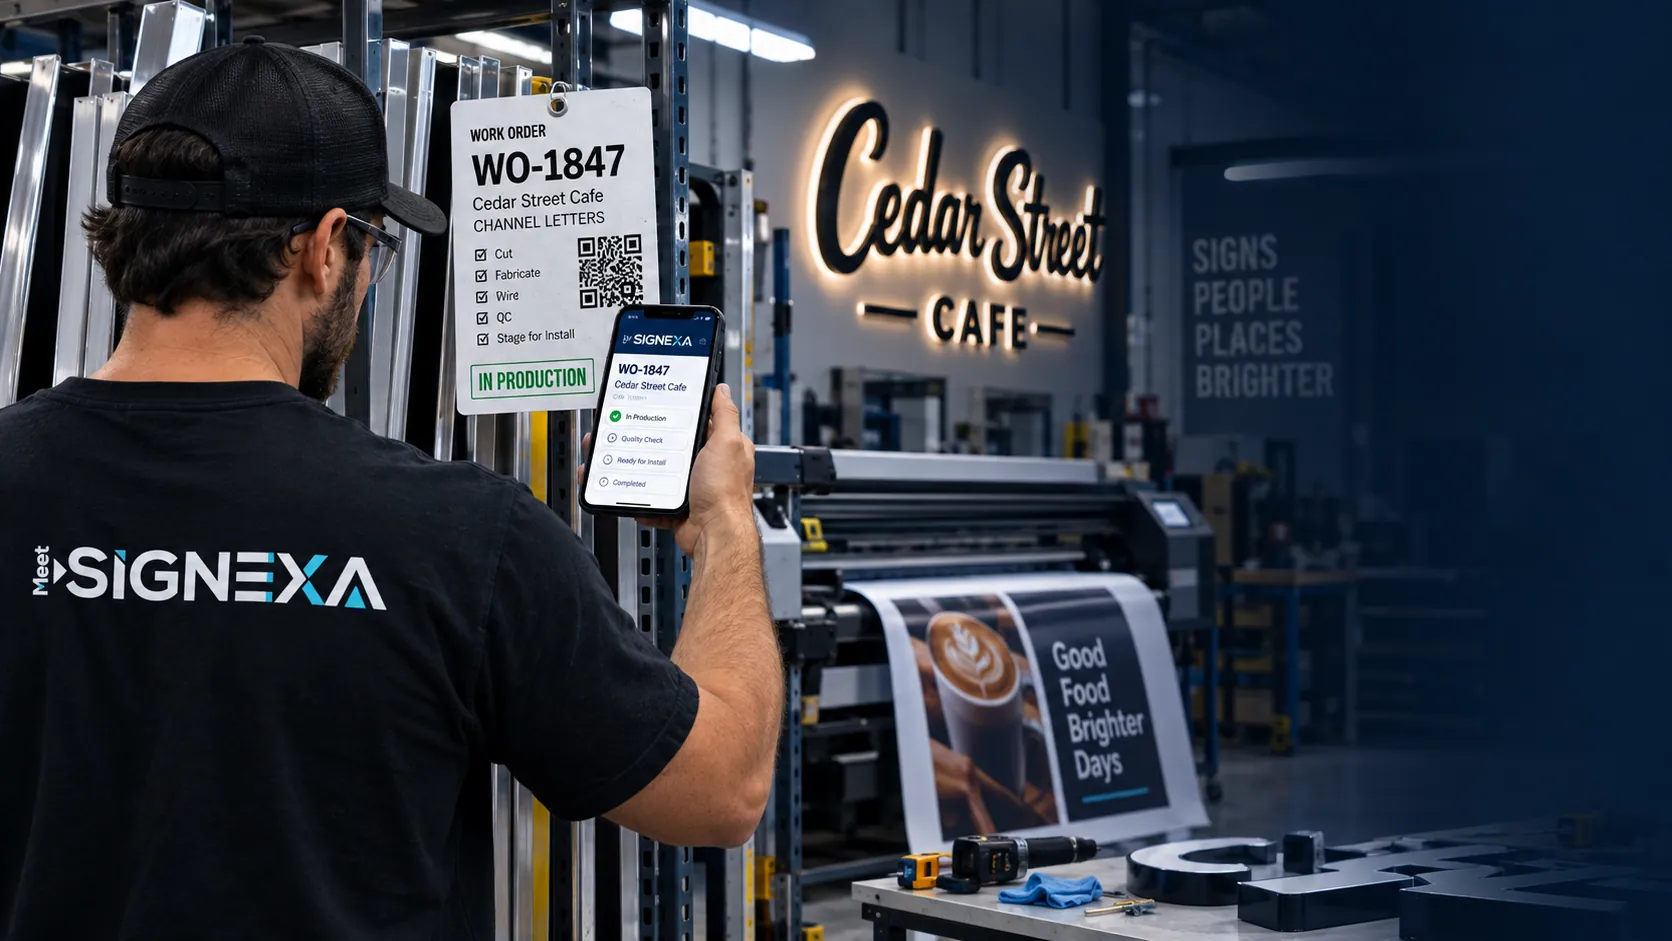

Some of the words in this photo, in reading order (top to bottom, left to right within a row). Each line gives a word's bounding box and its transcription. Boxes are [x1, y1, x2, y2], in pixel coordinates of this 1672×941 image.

[470, 127, 505, 142] WORK
[508, 124, 546, 139] ORDER
[472, 144, 625, 186] WO-1847
[472, 195, 516, 211] Cedar
[521, 191, 566, 208] Street
[570, 188, 604, 204] Cafe
[812, 100, 985, 274] Cedar
[990, 147, 1106, 282] Street
[473, 216, 541, 232] CHANNEL
[545, 211, 605, 227] LETTERS
[495, 249, 513, 260] Cut
[1192, 233, 1278, 274] SIGNS
[495, 268, 541, 280] Fabricate
[496, 290, 519, 302] Wire
[1193, 277, 1300, 316] PEOPLE
[496, 312, 512, 324] QC
[932, 295, 1028, 350] CAFE
[497, 332, 526, 345] Stage
[528, 331, 542, 342] for
[545, 329, 575, 340] Install
[633, 334, 692, 347] SIGNEXA
[1195, 320, 1304, 357] PLACES
[479, 372, 493, 391] IN
[497, 367, 587, 390] PRODUCTION
[618, 363, 670, 376] WO-1847
[1196, 362, 1334, 399] BRIGHTER
[614, 380, 639, 390] Cedar
[640, 381, 666, 391] Street
[668, 382, 687, 392] Cafe
[633, 414, 666, 422] Production
[644, 436, 663, 444] Check
[617, 457, 637, 465] Ready
[648, 458, 666, 466] Install
[612, 479, 646, 488] Completed
[32, 545, 50, 596] Meet
[65, 546, 387, 610] SIGNEXA
[1051, 637, 1108, 671] Good
[1059, 672, 1111, 707] Food
[1067, 708, 1145, 748] Brighter
[1074, 749, 1124, 784] Days
